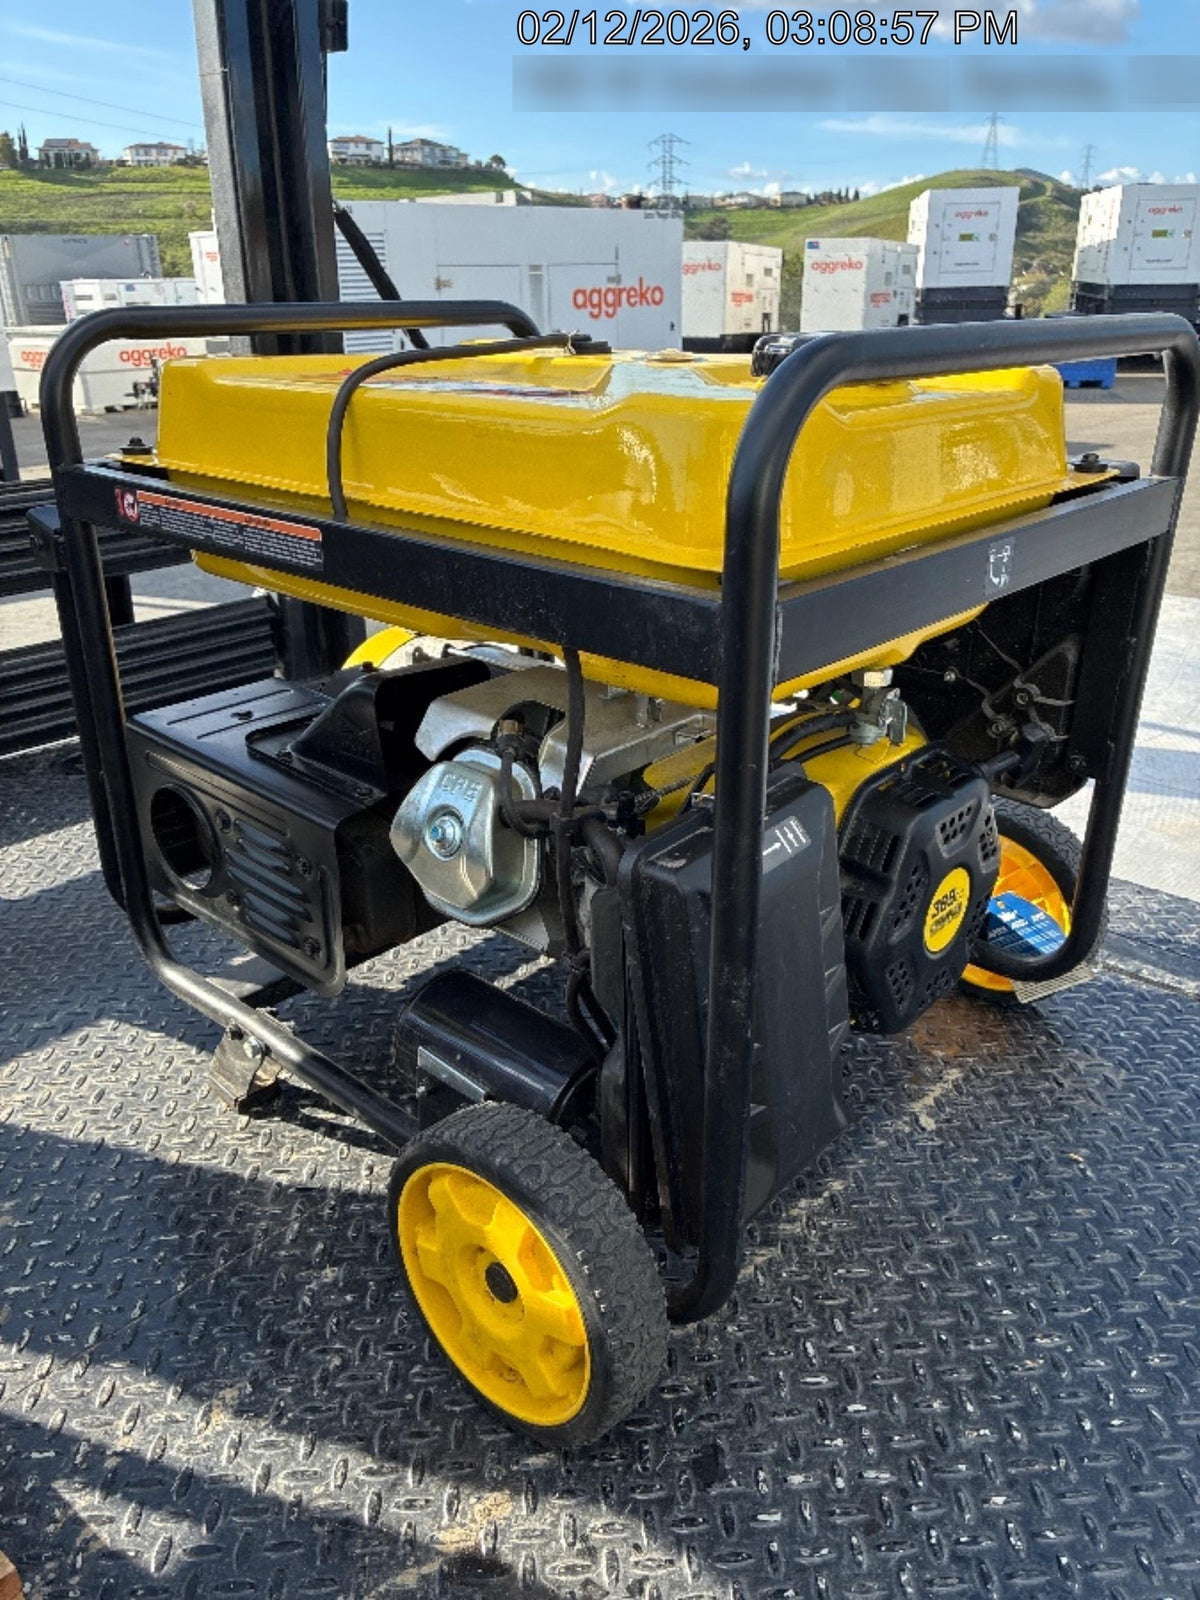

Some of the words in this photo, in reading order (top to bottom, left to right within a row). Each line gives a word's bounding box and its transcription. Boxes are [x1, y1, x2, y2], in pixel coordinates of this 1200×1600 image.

[682, 258, 722, 276] ggreko
[811, 257, 863, 274] aggreko
[572, 276, 665, 319] aggreko
[21, 351, 47, 369] aggr
[119, 342, 187, 367] aggreko
